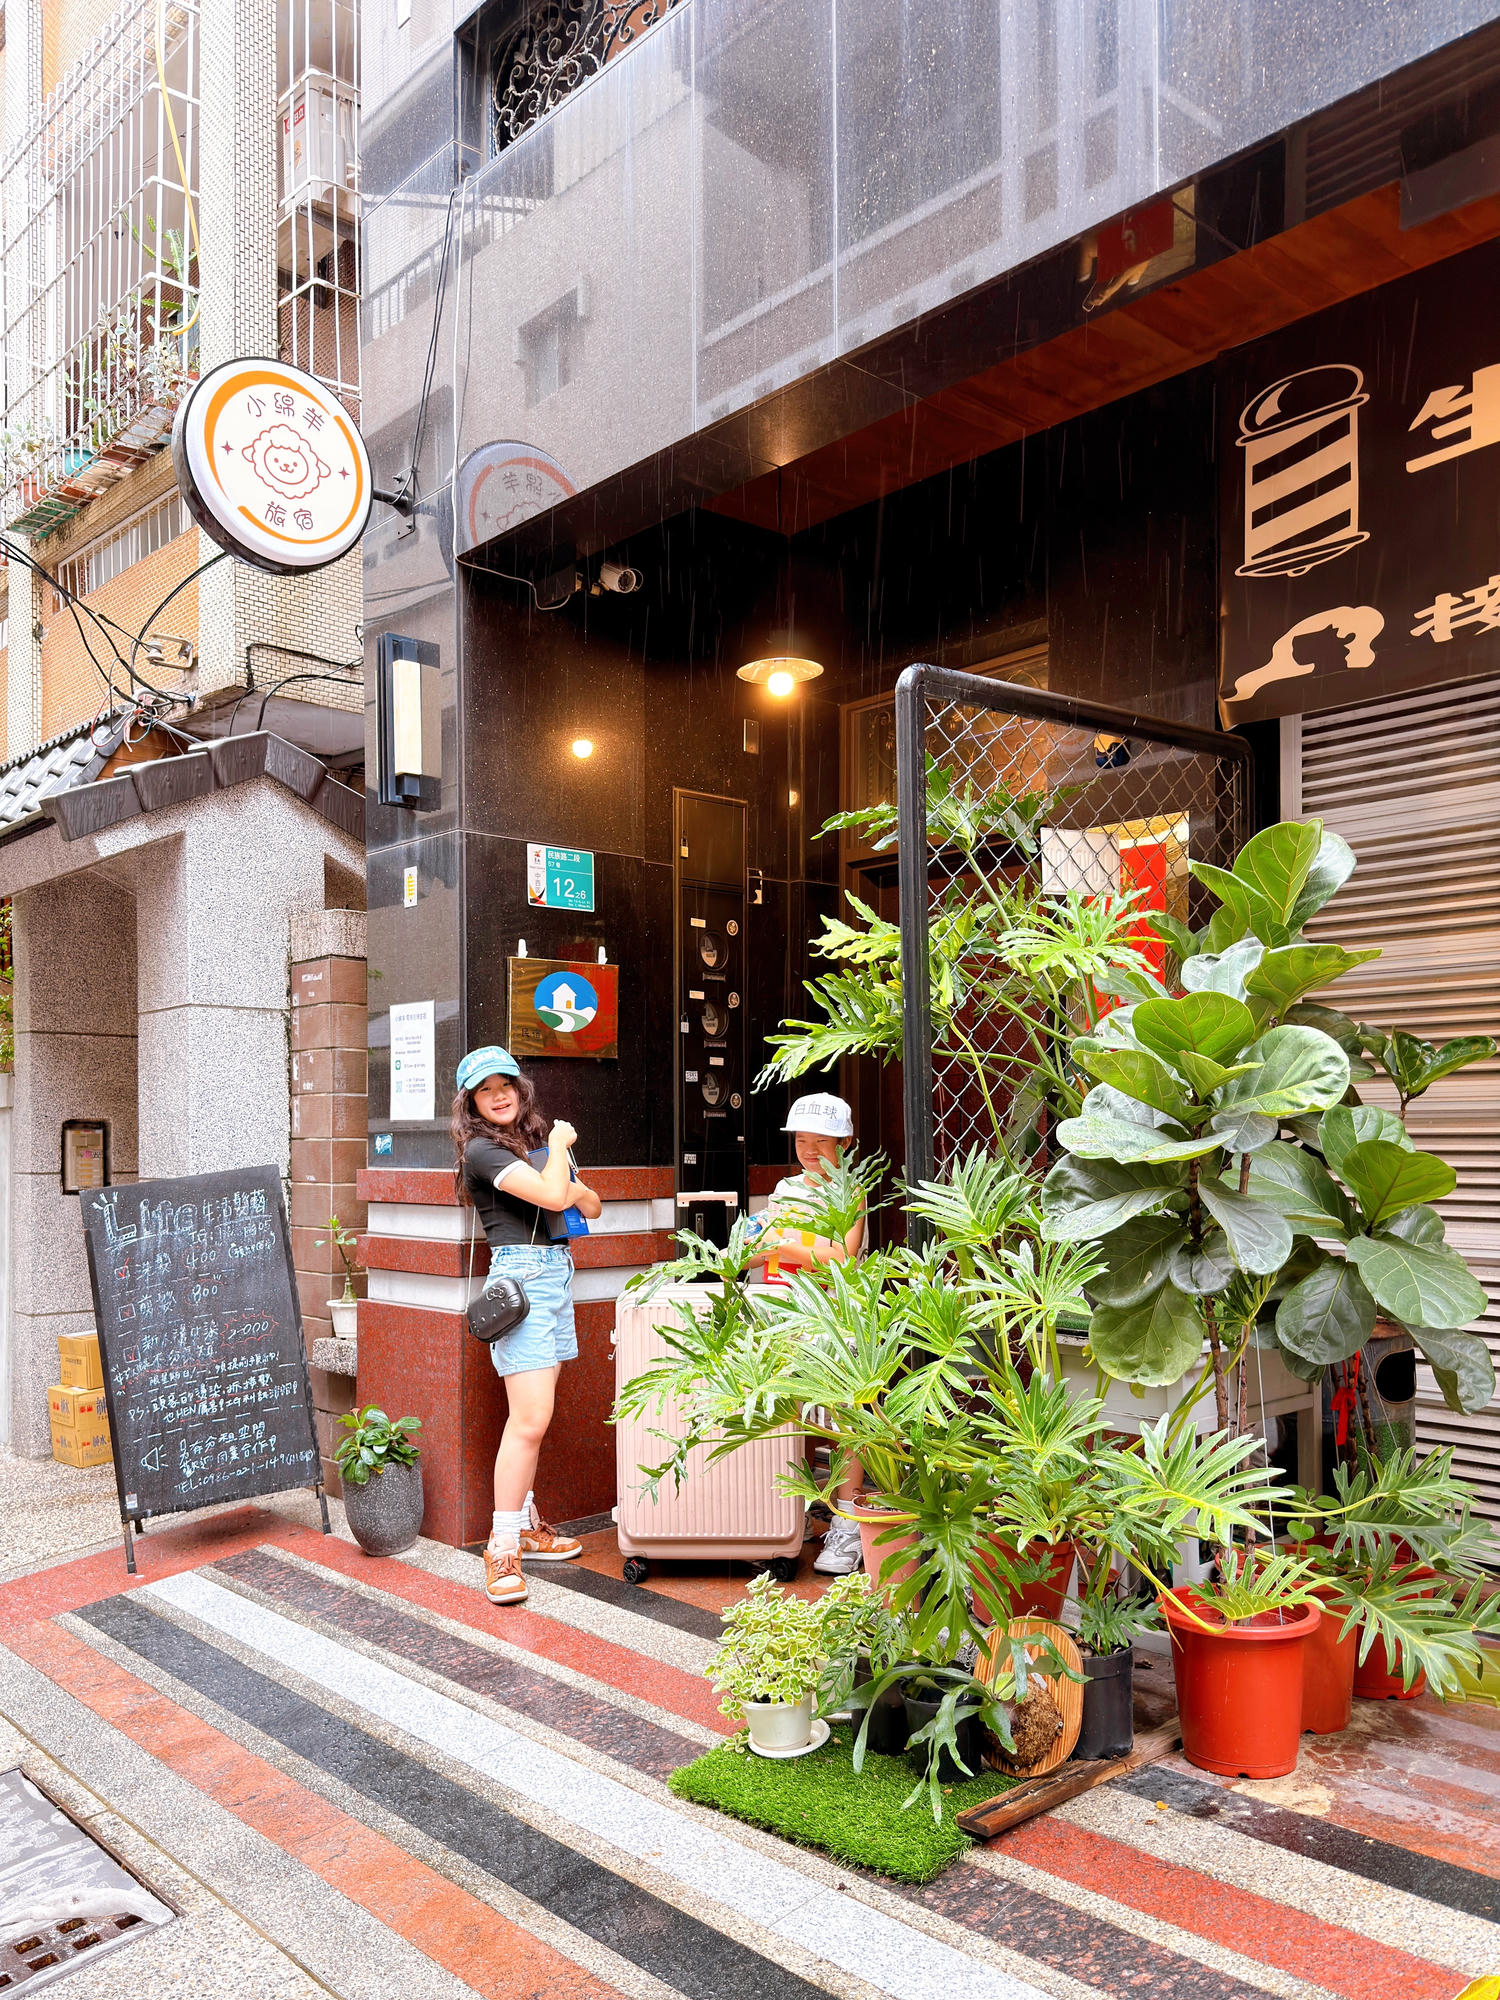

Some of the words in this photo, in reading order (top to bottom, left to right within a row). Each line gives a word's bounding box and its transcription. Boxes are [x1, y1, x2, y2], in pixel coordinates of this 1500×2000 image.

[264, 501, 314, 531] 旅宿
[794, 1101, 838, 1120] 白血球
[186, 1250, 217, 1269] 400
